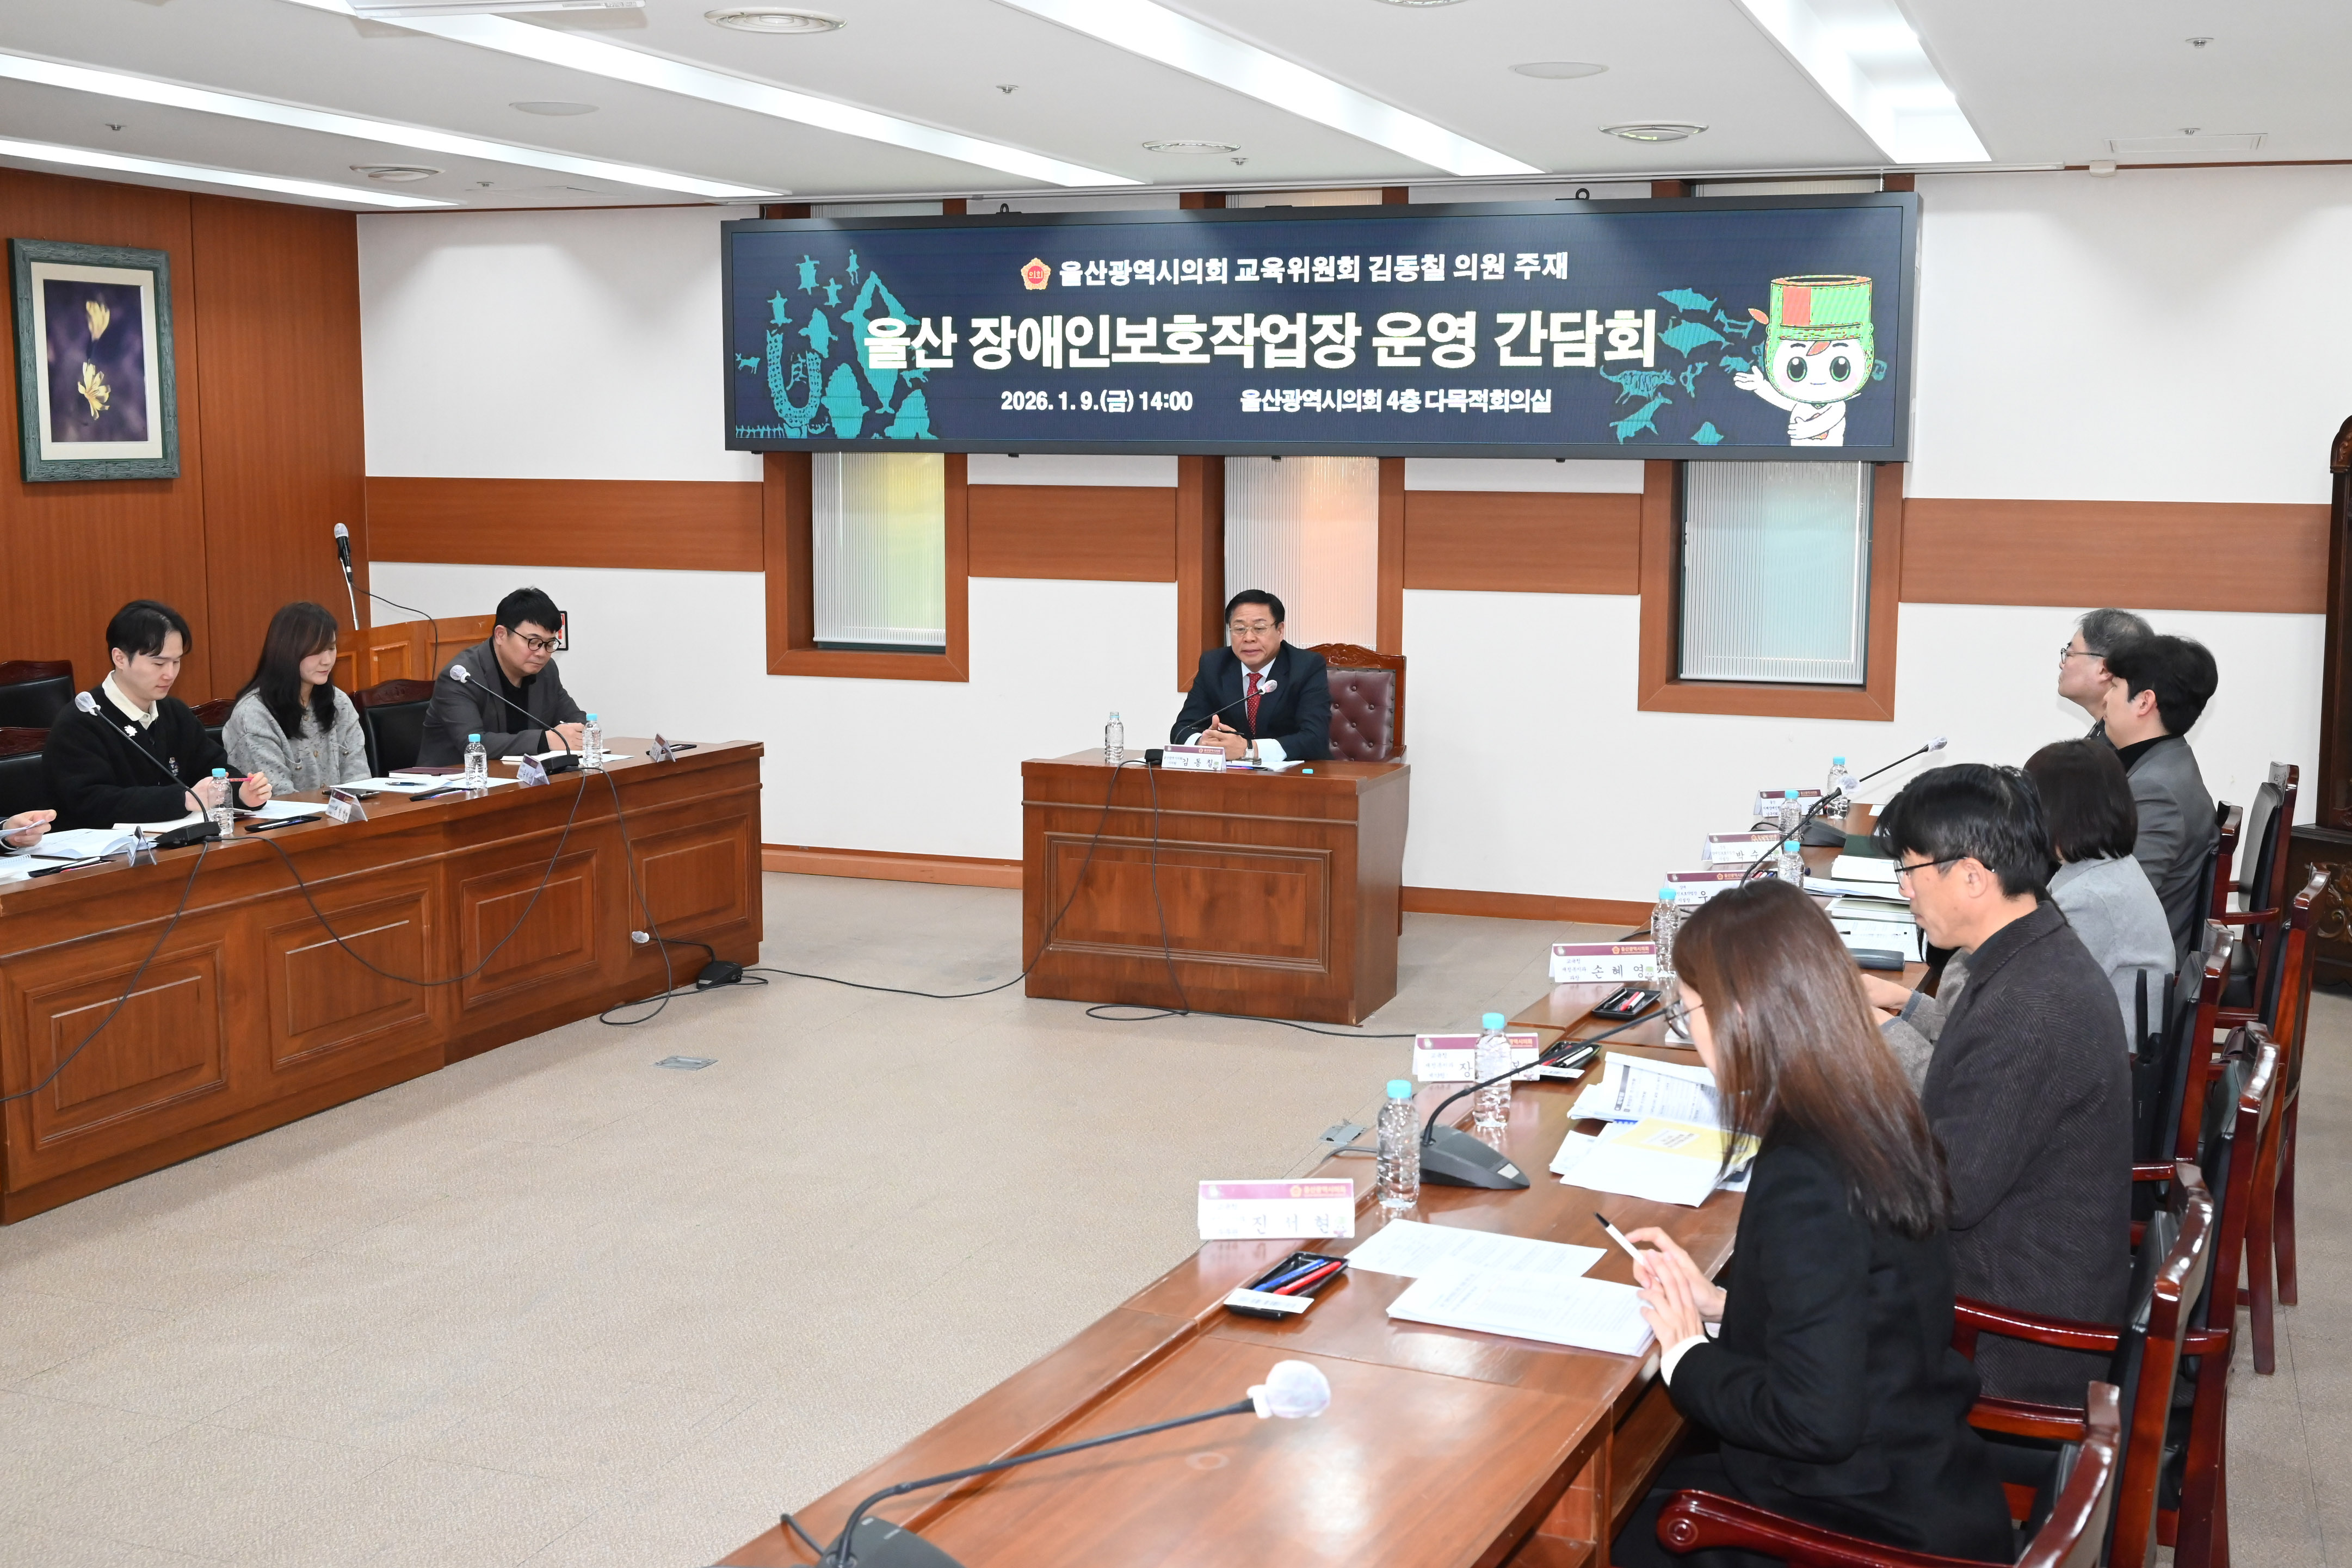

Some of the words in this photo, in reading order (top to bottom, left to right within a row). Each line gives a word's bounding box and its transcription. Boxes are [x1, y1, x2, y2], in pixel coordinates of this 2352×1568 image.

[1059, 257, 1228, 287] 울산광역시의회
[1234, 255, 1360, 283] 교육위원회
[1368, 254, 1446, 282] 김동칠
[1453, 252, 1505, 281] 의원
[1514, 251, 1568, 280] 주재
[864, 316, 958, 369] 울산
[968, 312, 1362, 370] 장애인보호작업장
[1372, 311, 1477, 369] 운영
[1494, 309, 1656, 368] 간담회
[1001, 391, 1053, 411] 2026.
[1139, 391, 1193, 411] 14:00
[1240, 388, 1382, 412] 울산광역시의회
[1386, 388, 1422, 413] 4층
[1424, 388, 1552, 413] 다목적회의실
